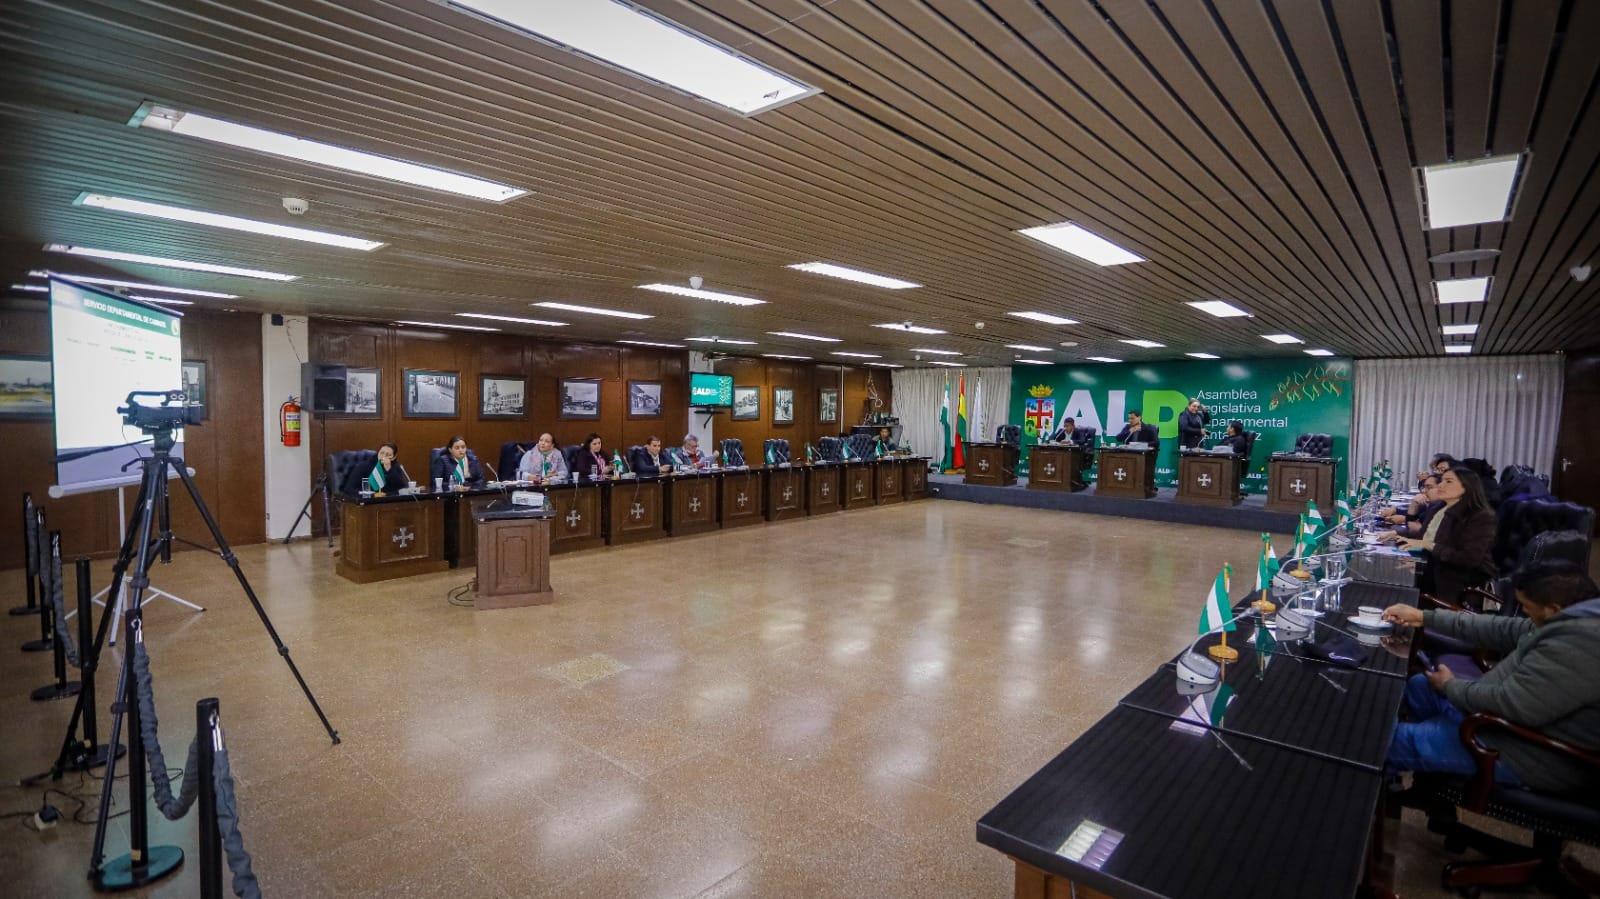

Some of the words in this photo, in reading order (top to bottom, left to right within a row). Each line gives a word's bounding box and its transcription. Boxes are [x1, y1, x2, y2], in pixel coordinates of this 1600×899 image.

[83, 298, 107, 312] SERVICIO
[107, 304, 143, 322] DEPARTAMENTAL
[1196, 388, 1258, 400] Asamblea
[1055, 389, 1189, 439] ALD
[1199, 402, 1261, 415] egislativa
